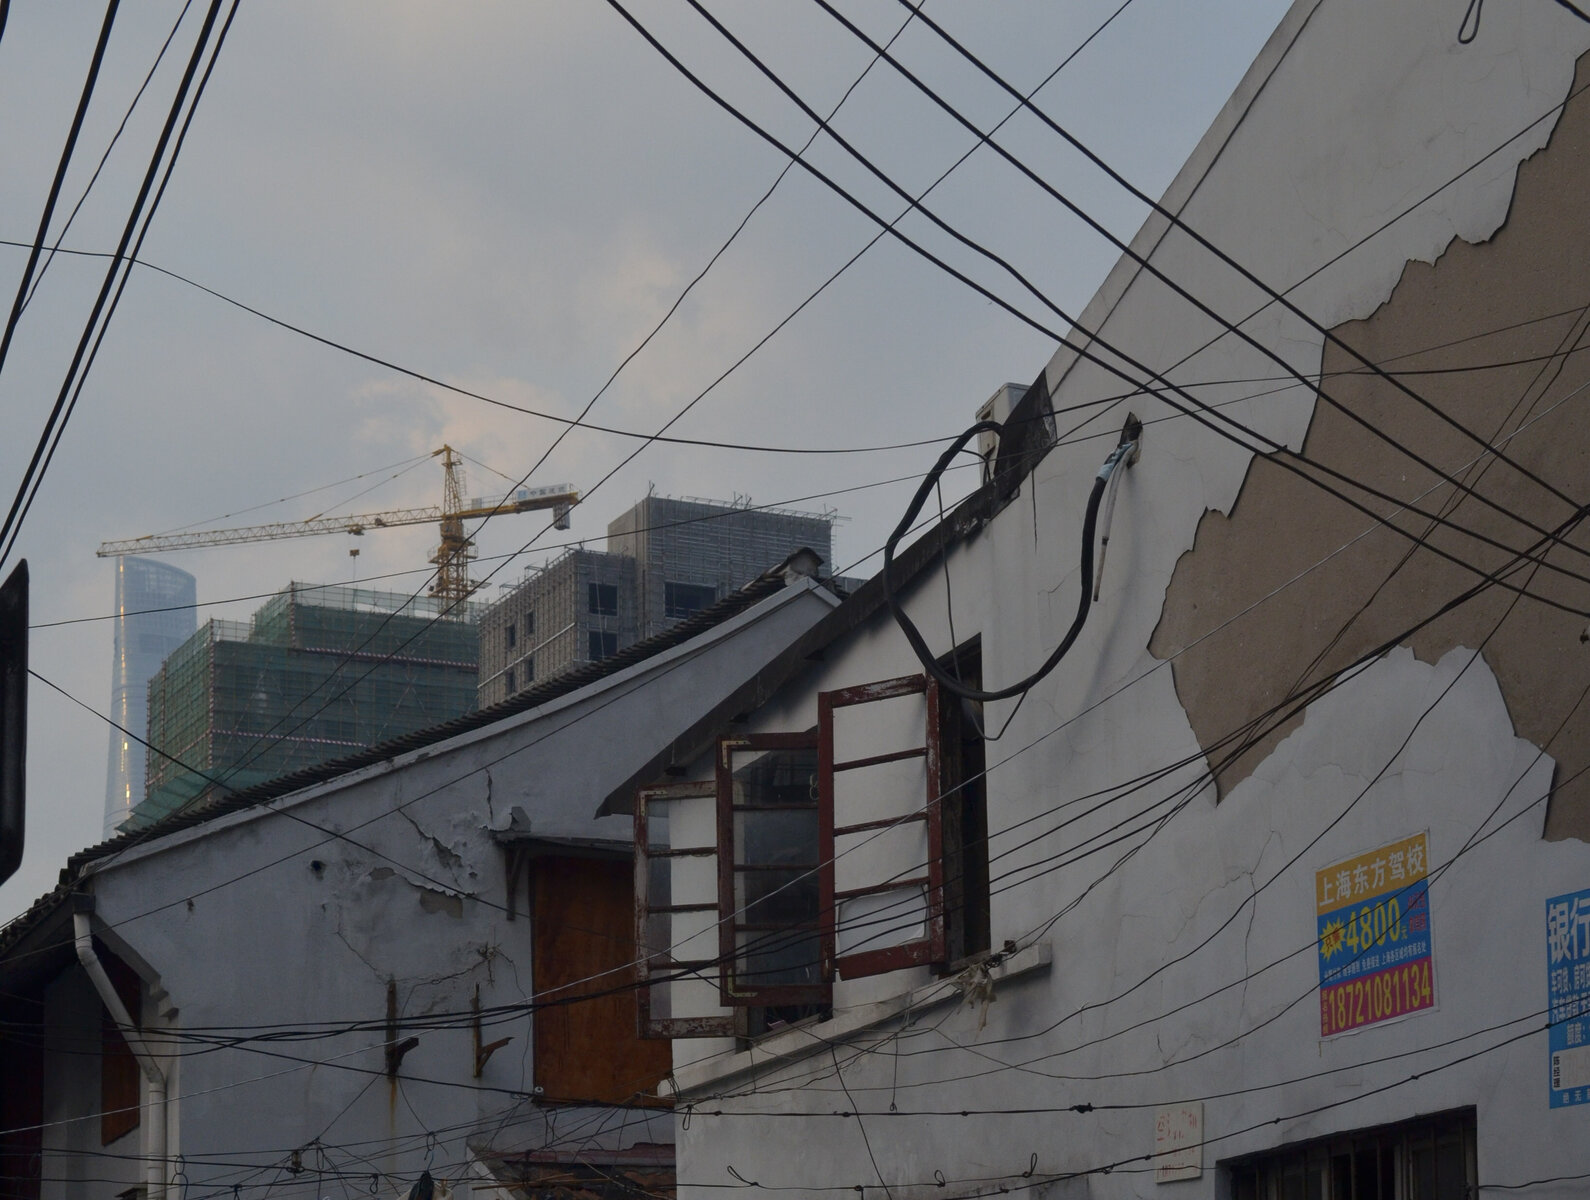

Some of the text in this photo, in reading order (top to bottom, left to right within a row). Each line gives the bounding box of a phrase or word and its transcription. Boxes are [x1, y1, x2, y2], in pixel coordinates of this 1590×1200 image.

[1320, 844, 1424, 906] 上海东方驾校
[1329, 961, 1431, 1031] 18721081134
